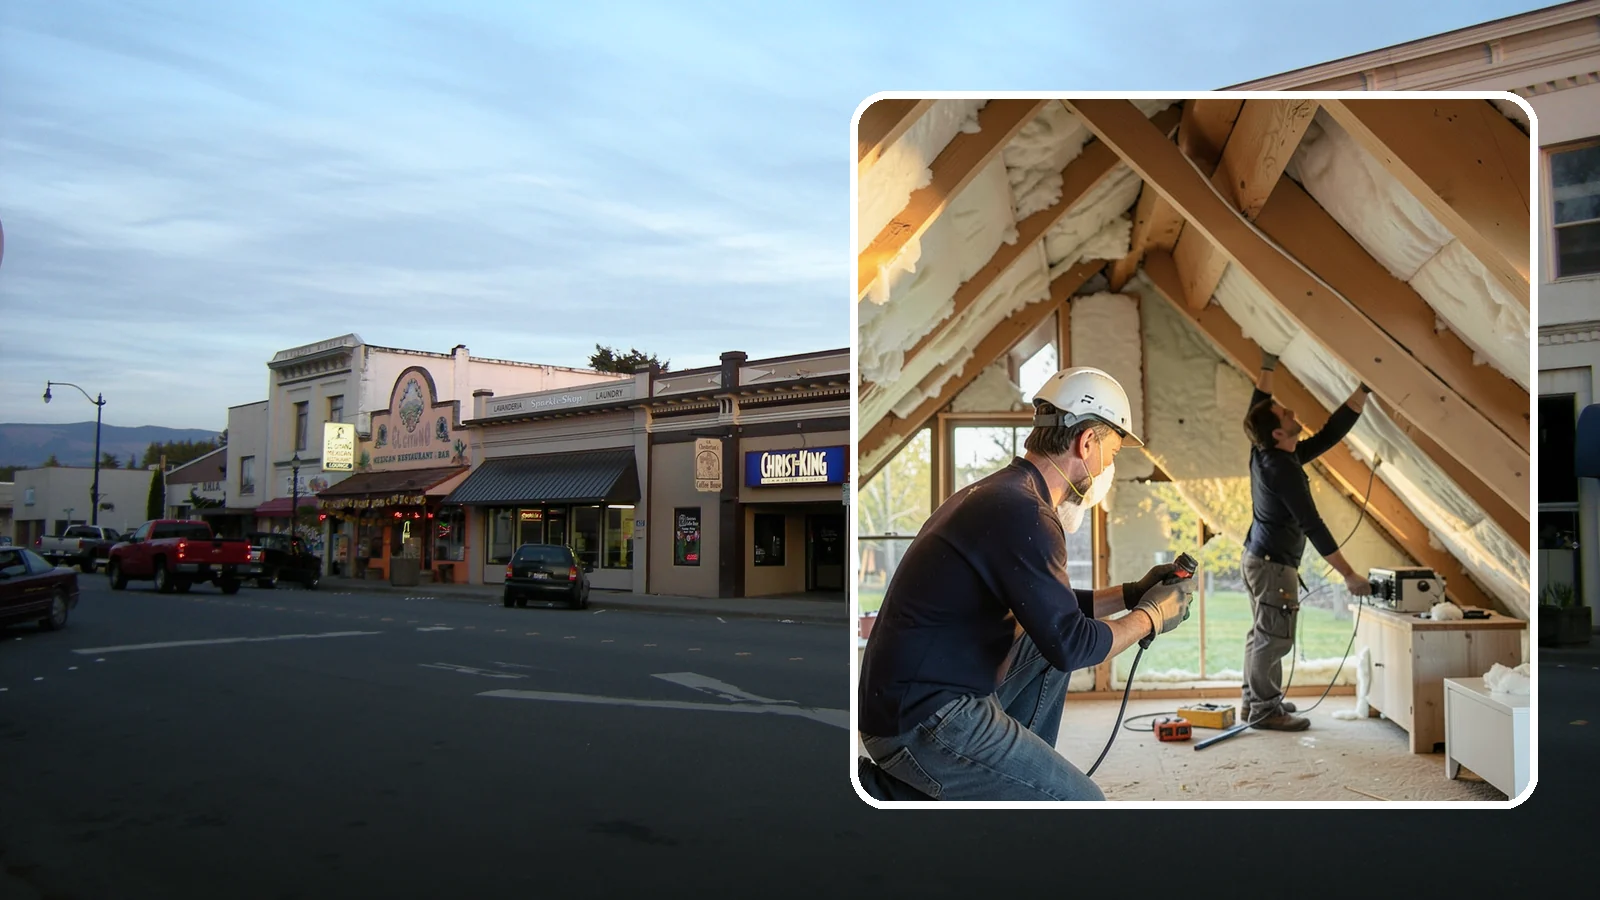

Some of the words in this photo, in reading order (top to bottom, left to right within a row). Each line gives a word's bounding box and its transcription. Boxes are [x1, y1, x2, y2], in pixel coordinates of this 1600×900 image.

[530, 396, 561, 409] Sparkle
[561, 394, 582, 405] Shop
[595, 389, 623, 400] LAUNDRY
[493, 402, 523, 413] LAVANDERIA
[373, 454, 396, 464] MEXICAN
[397, 451, 434, 462] RESTAURANT
[438, 450, 450, 459] BAR
[760, 452, 797, 478] CHRIST
[799, 450, 828, 476] KING
